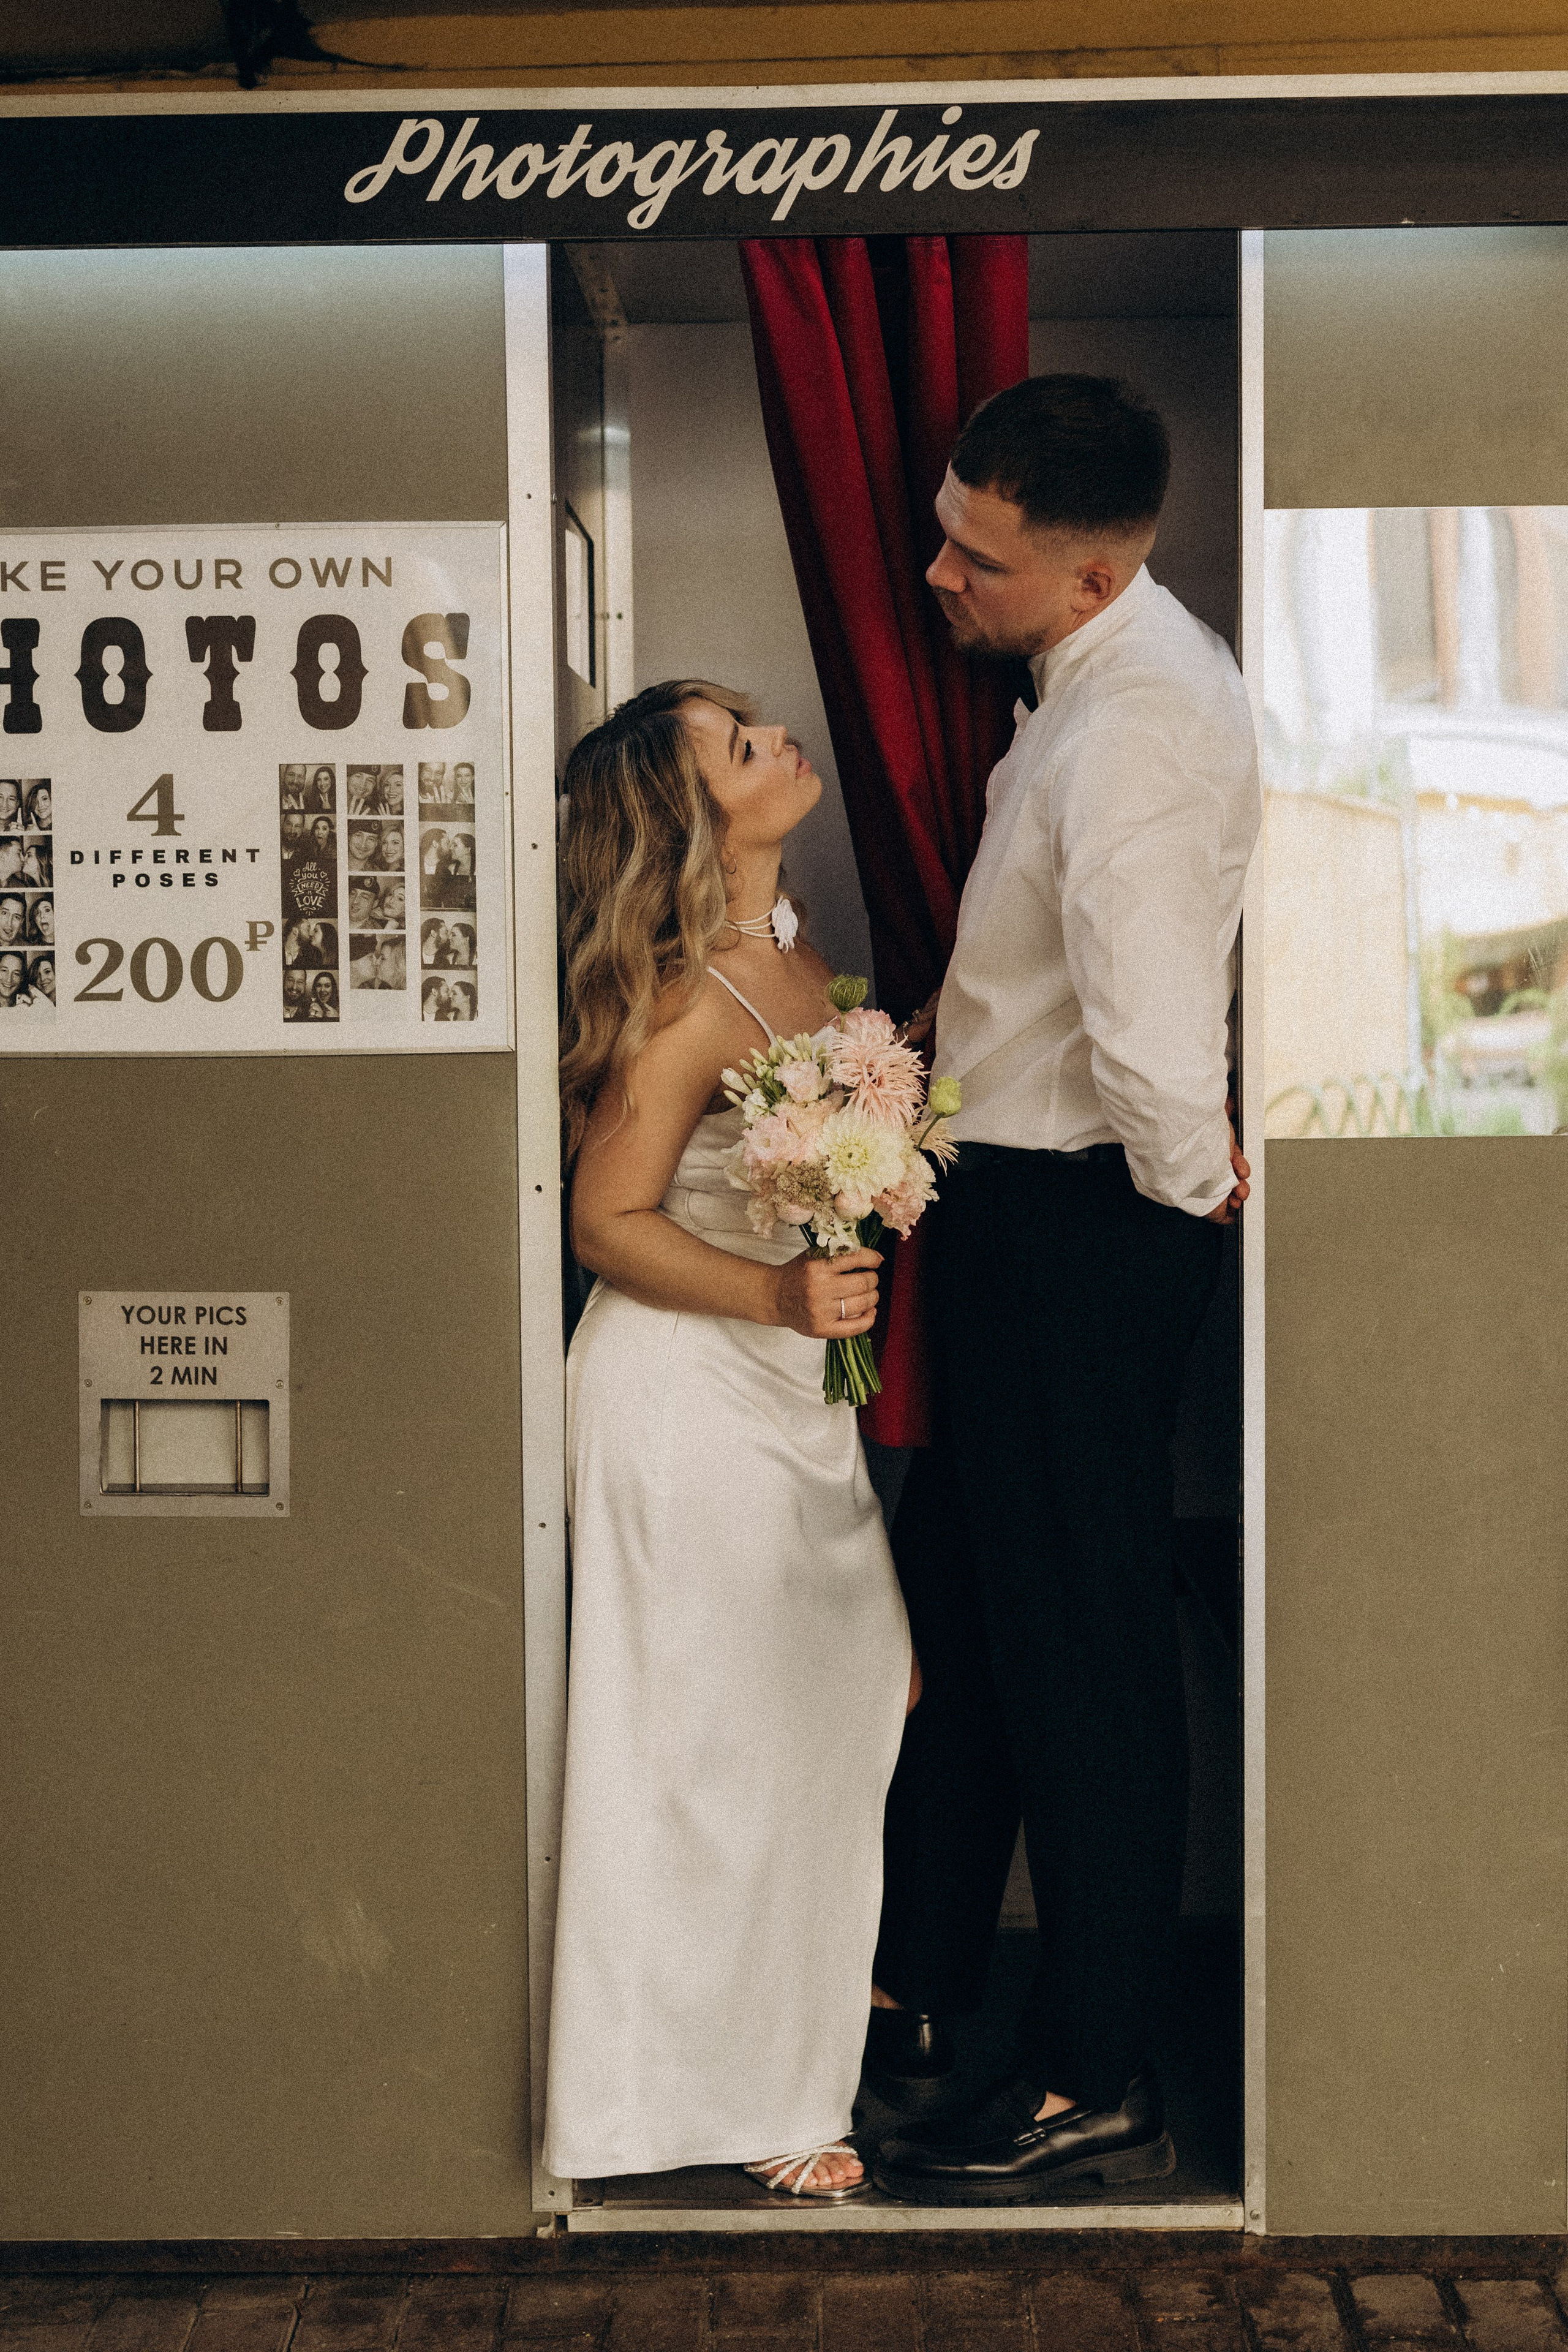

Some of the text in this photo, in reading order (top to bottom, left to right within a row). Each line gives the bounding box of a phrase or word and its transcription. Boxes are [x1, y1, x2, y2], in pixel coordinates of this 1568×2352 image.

[344, 105, 1041, 230] Photographies
[0, 557, 393, 592] KE YOUR OWN
[126, 774, 185, 837] 4
[70, 848, 260, 865] DIFFERENT
[302, 862, 317, 872] All
[112, 872, 219, 888] POSES
[298, 873, 318, 882] you
[296, 895, 325, 907] LOVE
[121, 1305, 247, 1326] YOUR PICS
[140, 1335, 228, 1355] HERE IN
[149, 1365, 217, 1385] 2 MIN
